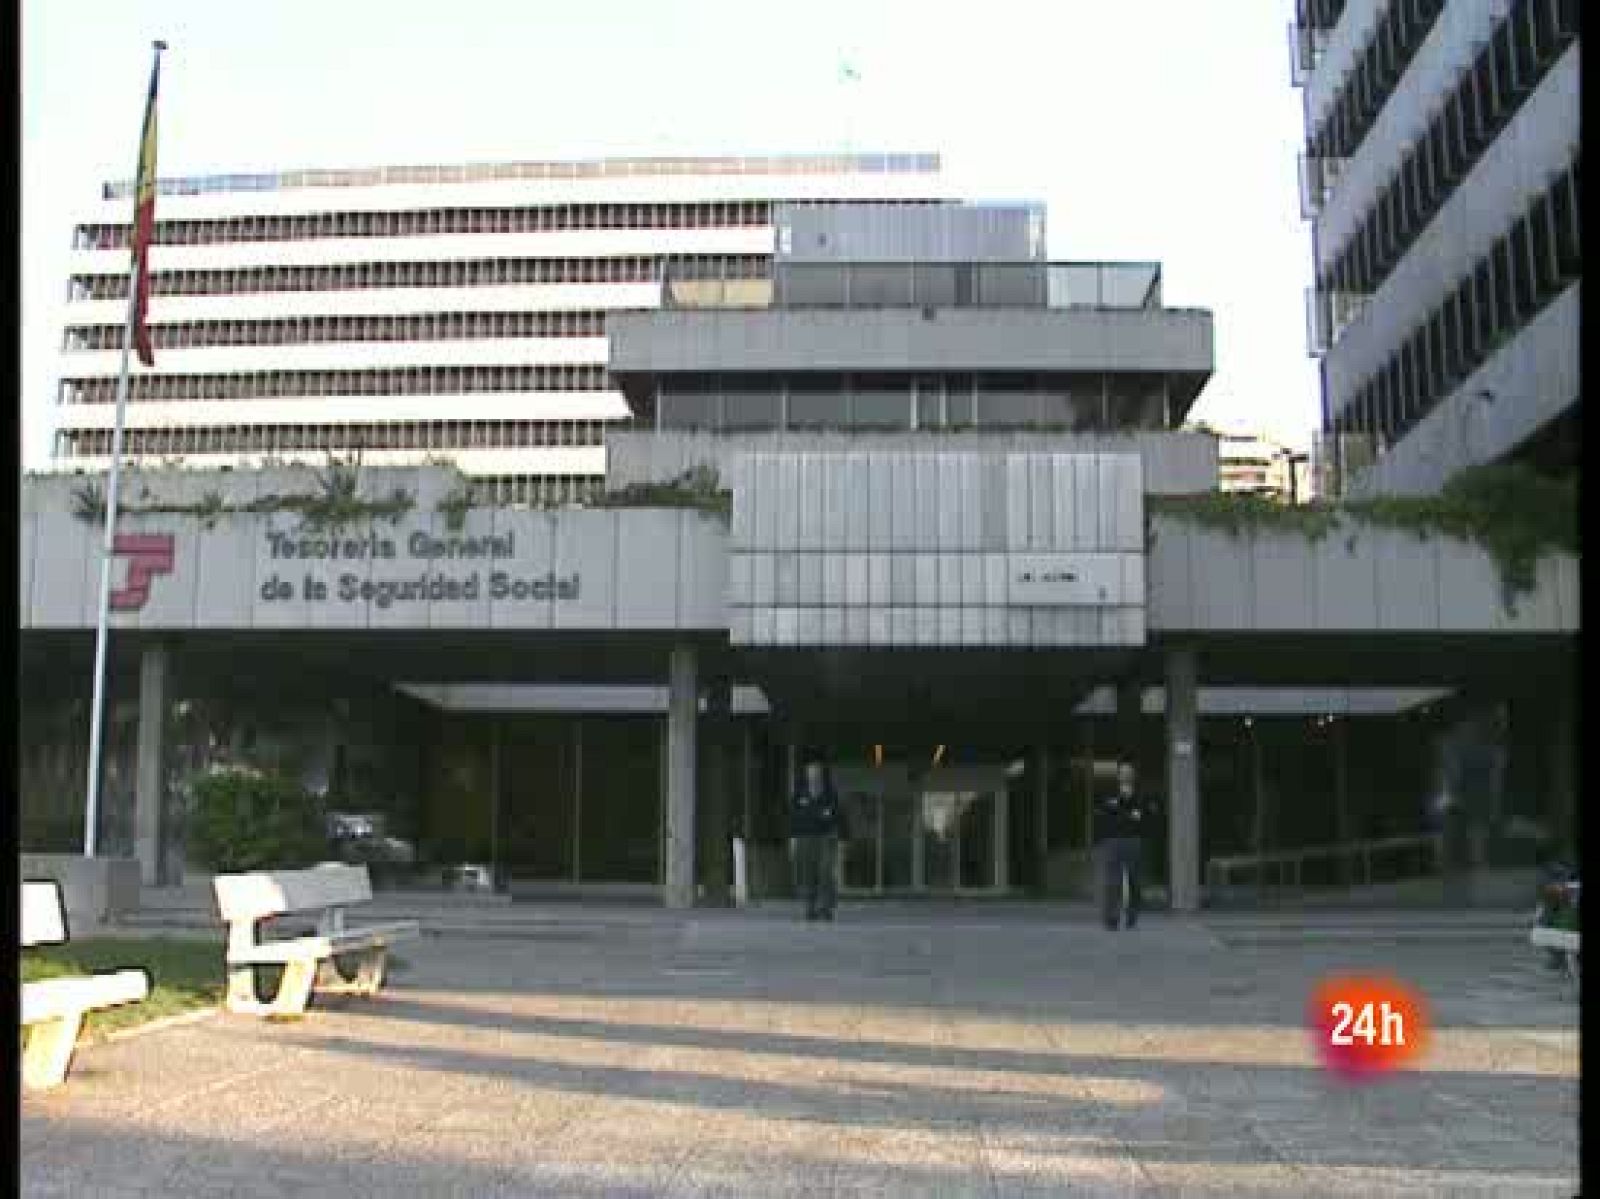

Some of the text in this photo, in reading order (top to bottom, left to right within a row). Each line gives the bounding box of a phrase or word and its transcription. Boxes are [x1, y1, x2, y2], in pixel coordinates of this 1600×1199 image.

[408, 530, 515, 559] General
[261, 571, 580, 608] de la Seguridad Social
